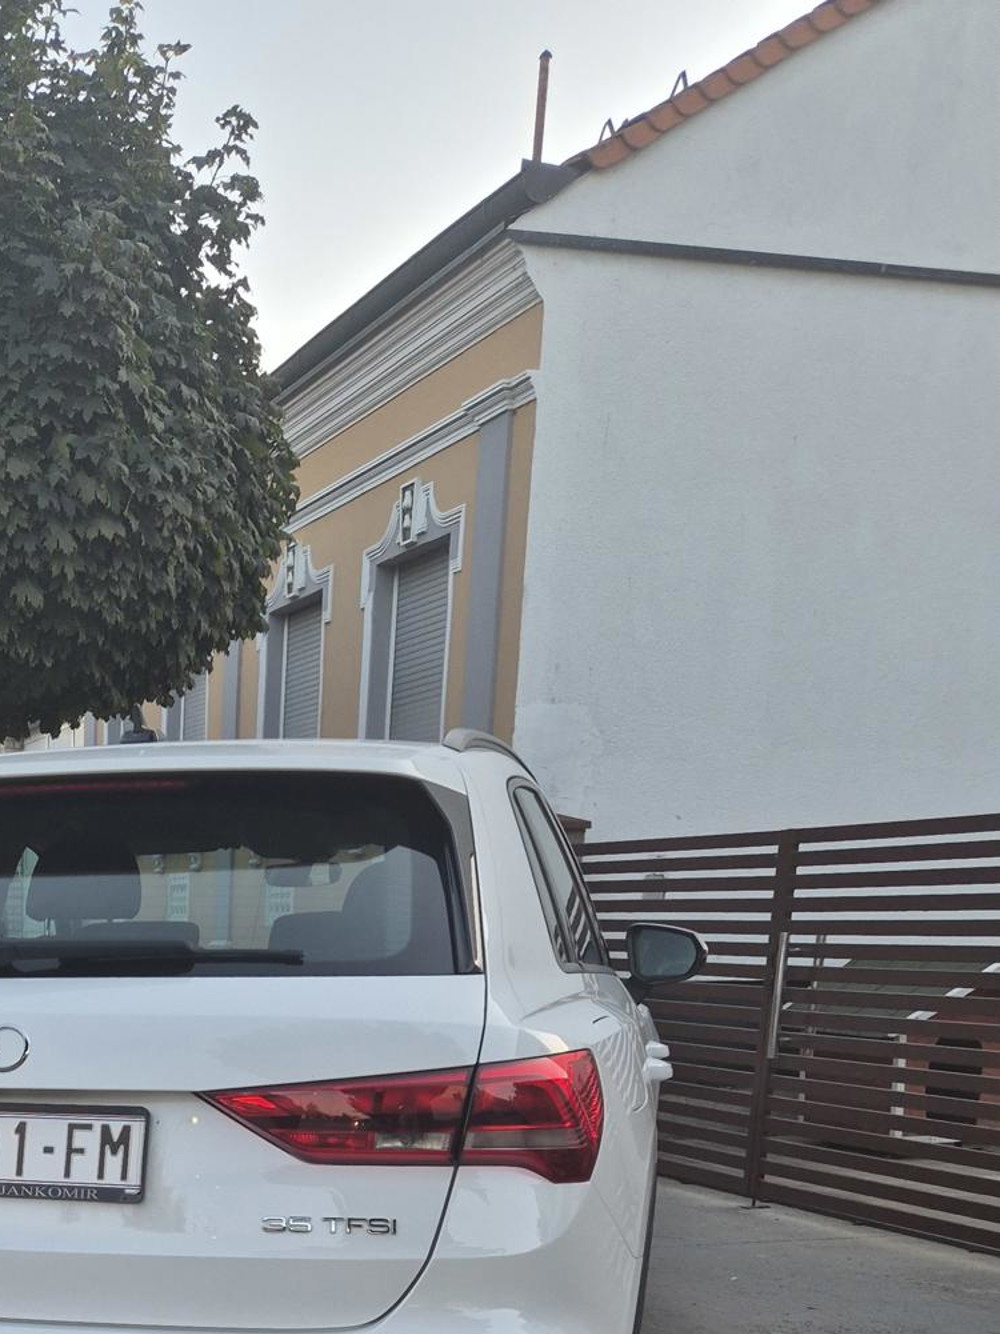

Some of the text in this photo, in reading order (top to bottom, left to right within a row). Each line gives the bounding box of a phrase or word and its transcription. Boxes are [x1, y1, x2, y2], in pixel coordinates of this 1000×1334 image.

[0, 1185, 99, 1200] JANKOMIR
[261, 1216, 397, 1235] 35 TFSI
